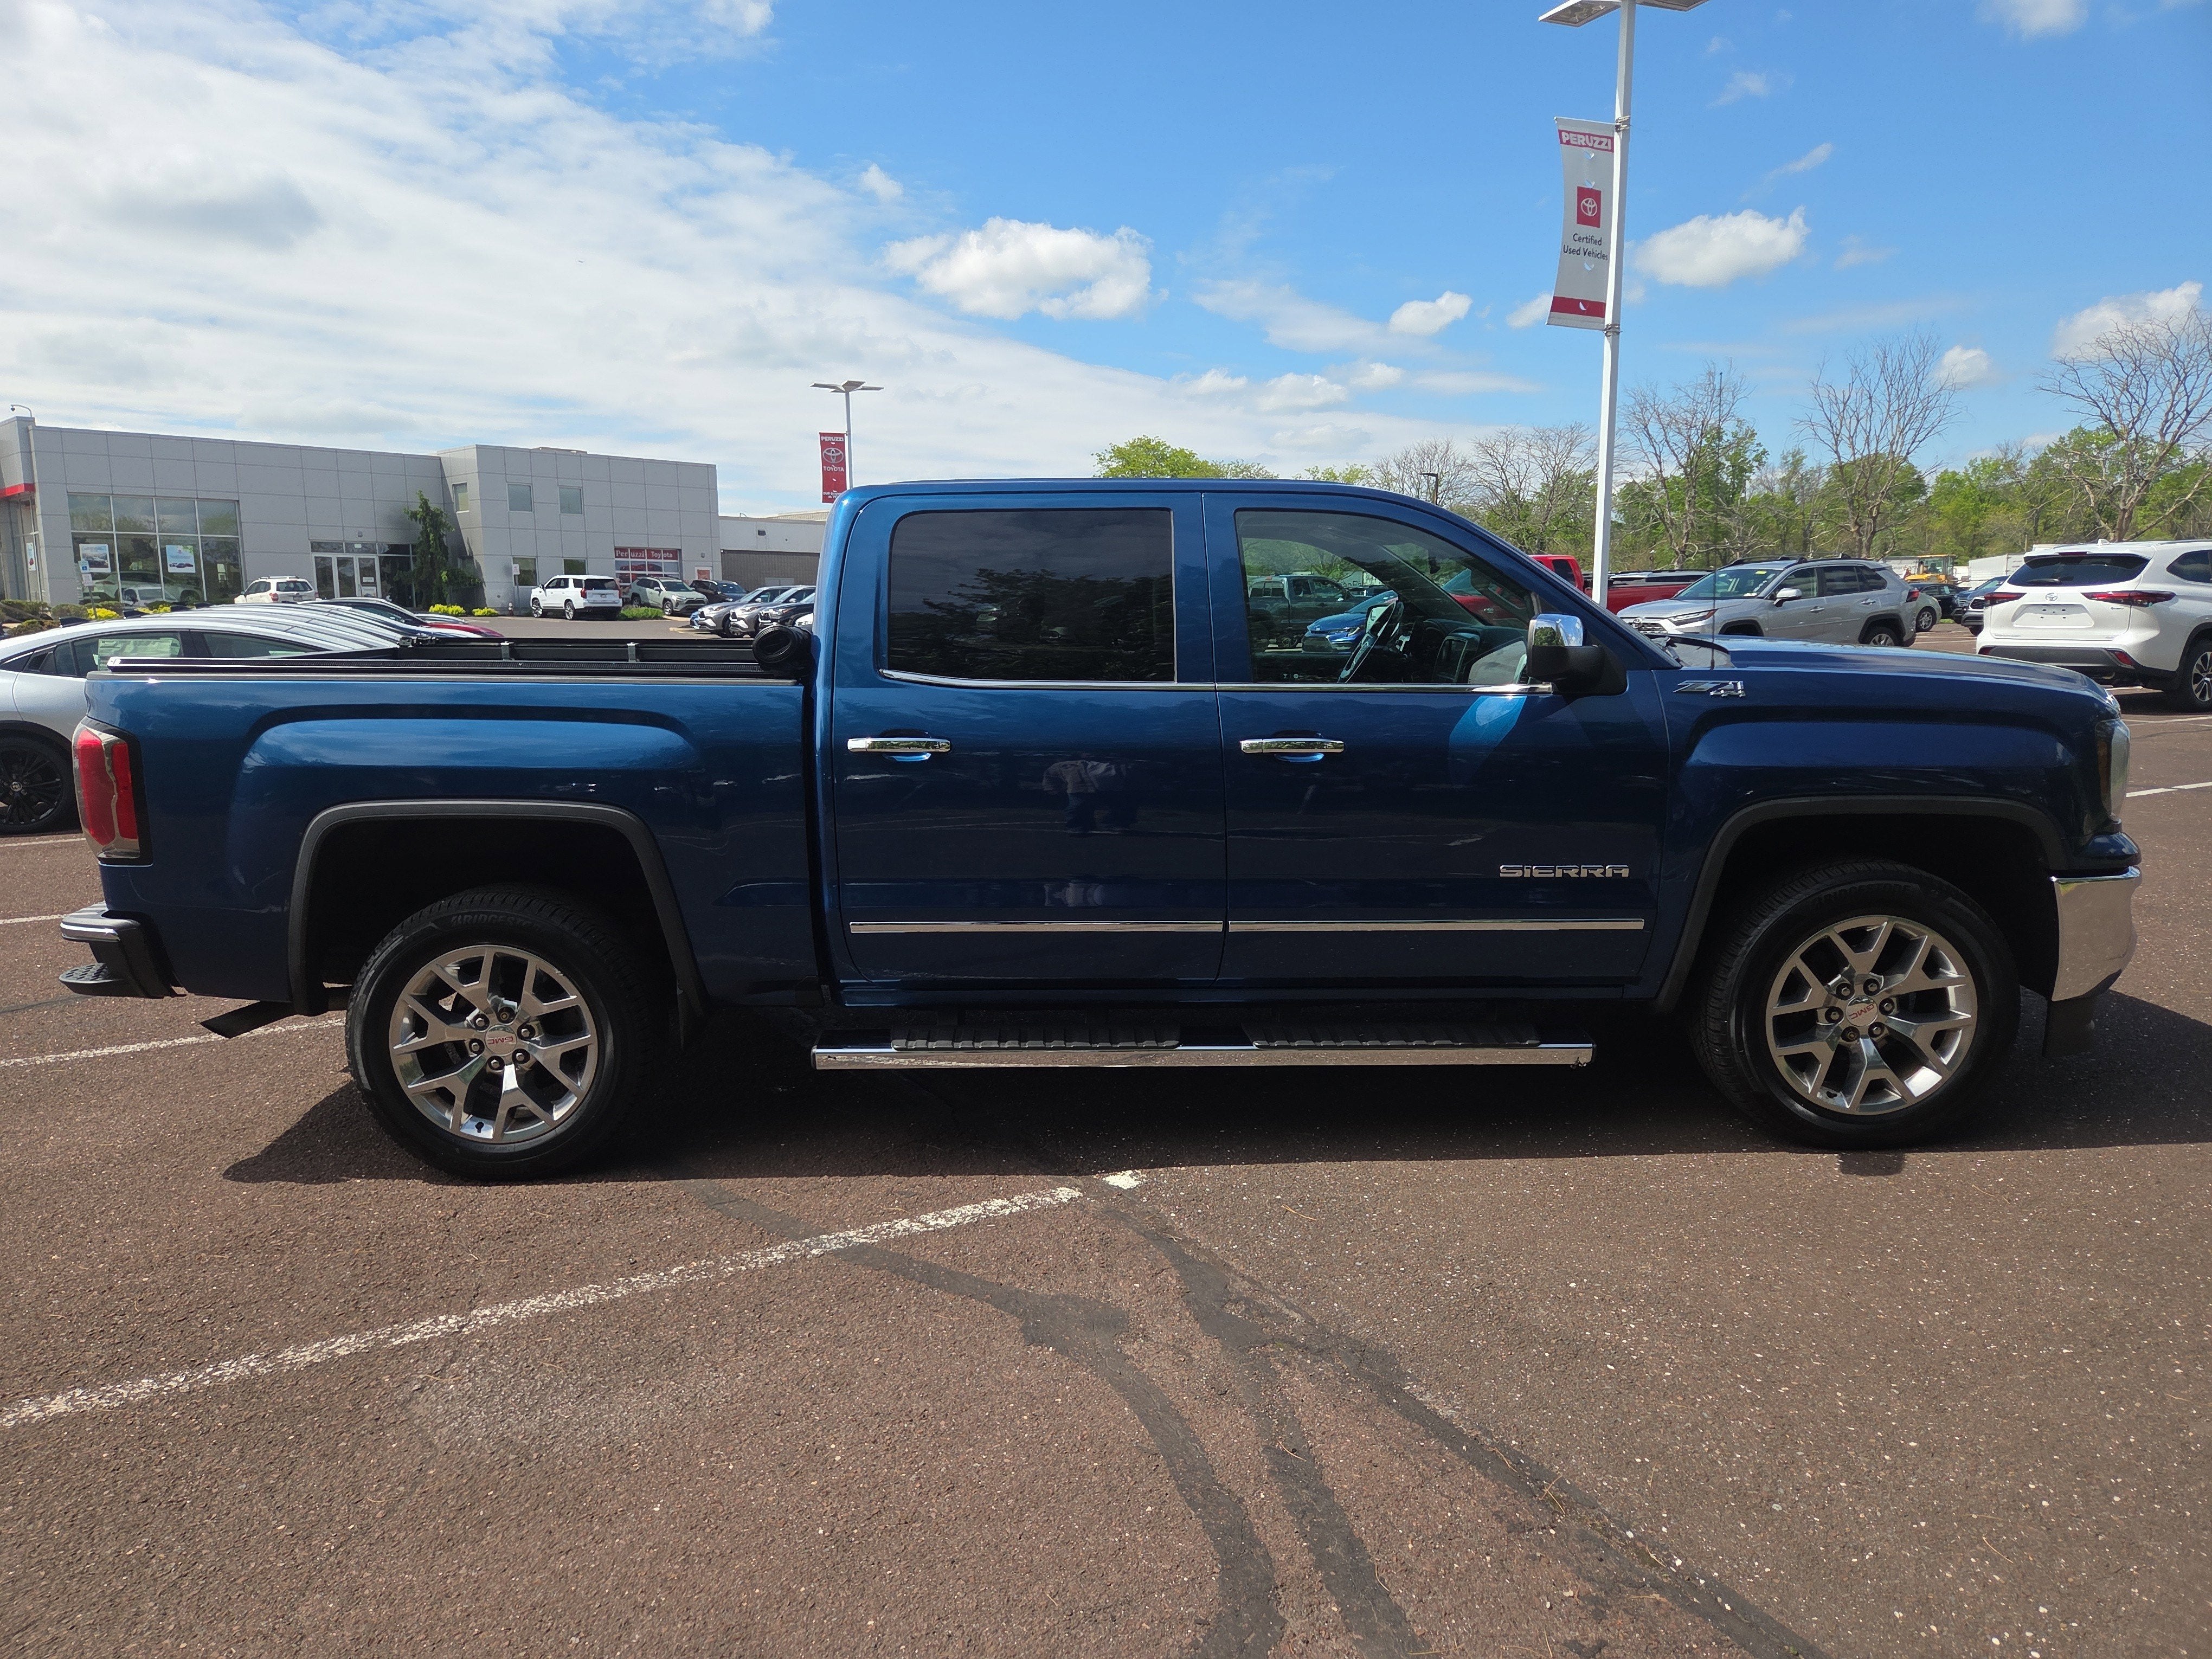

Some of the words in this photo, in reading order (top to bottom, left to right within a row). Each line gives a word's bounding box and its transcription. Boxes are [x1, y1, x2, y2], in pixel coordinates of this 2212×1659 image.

[1561, 132, 1612, 150] PERUZZI
[1573, 233, 1602, 246] Certified
[1563, 244, 1581, 255] Used
[1583, 247, 1609, 261] Vehicles
[616, 550, 644, 558] Peruzzi
[651, 551, 673, 559] Toyota
[1500, 865, 1629, 877] SIERRA
[1849, 1004, 1875, 1020] GMC
[487, 1036, 514, 1045] GMC
